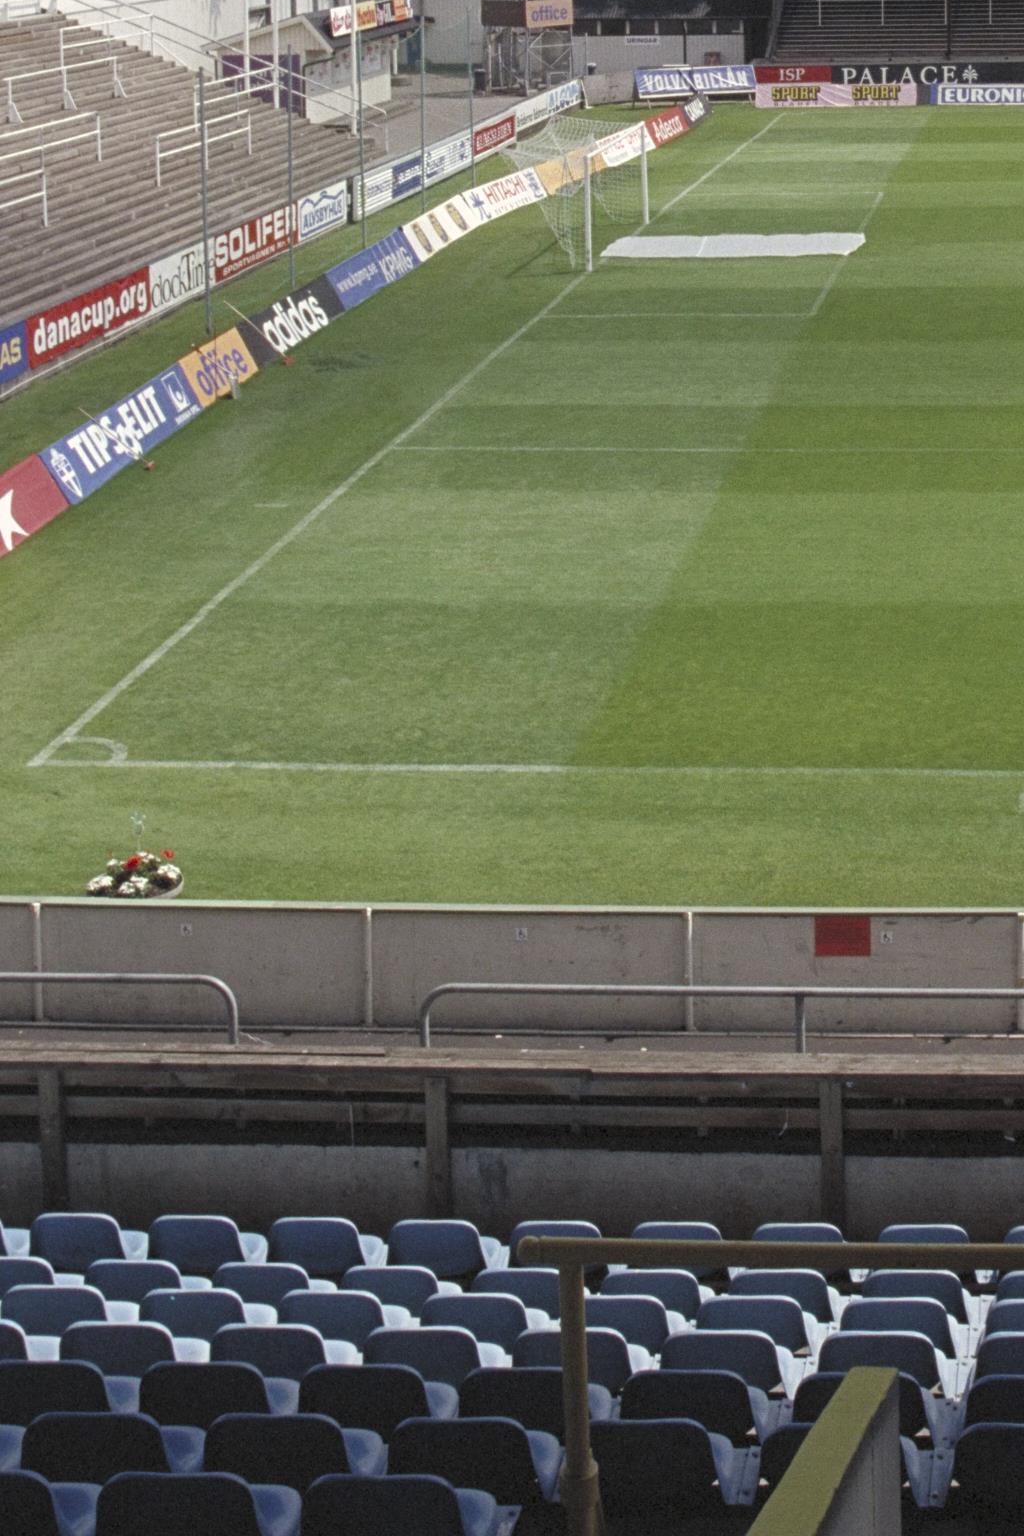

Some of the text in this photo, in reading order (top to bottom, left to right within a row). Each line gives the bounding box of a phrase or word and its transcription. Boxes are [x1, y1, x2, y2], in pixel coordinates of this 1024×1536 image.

[531, 5, 568, 22] office
[779, 68, 806, 81] ISP
[841, 66, 958, 85] PALACE
[771, 87, 821, 101] SPORT
[852, 86, 900, 100] SPORT
[652, 116, 683, 143] Adecco
[482, 174, 528, 205] HITACHI
[378, 246, 414, 284] KPMG
[33, 281, 148, 354] danacup.org
[262, 295, 330, 353] adidas
[196, 347, 249, 396] office
